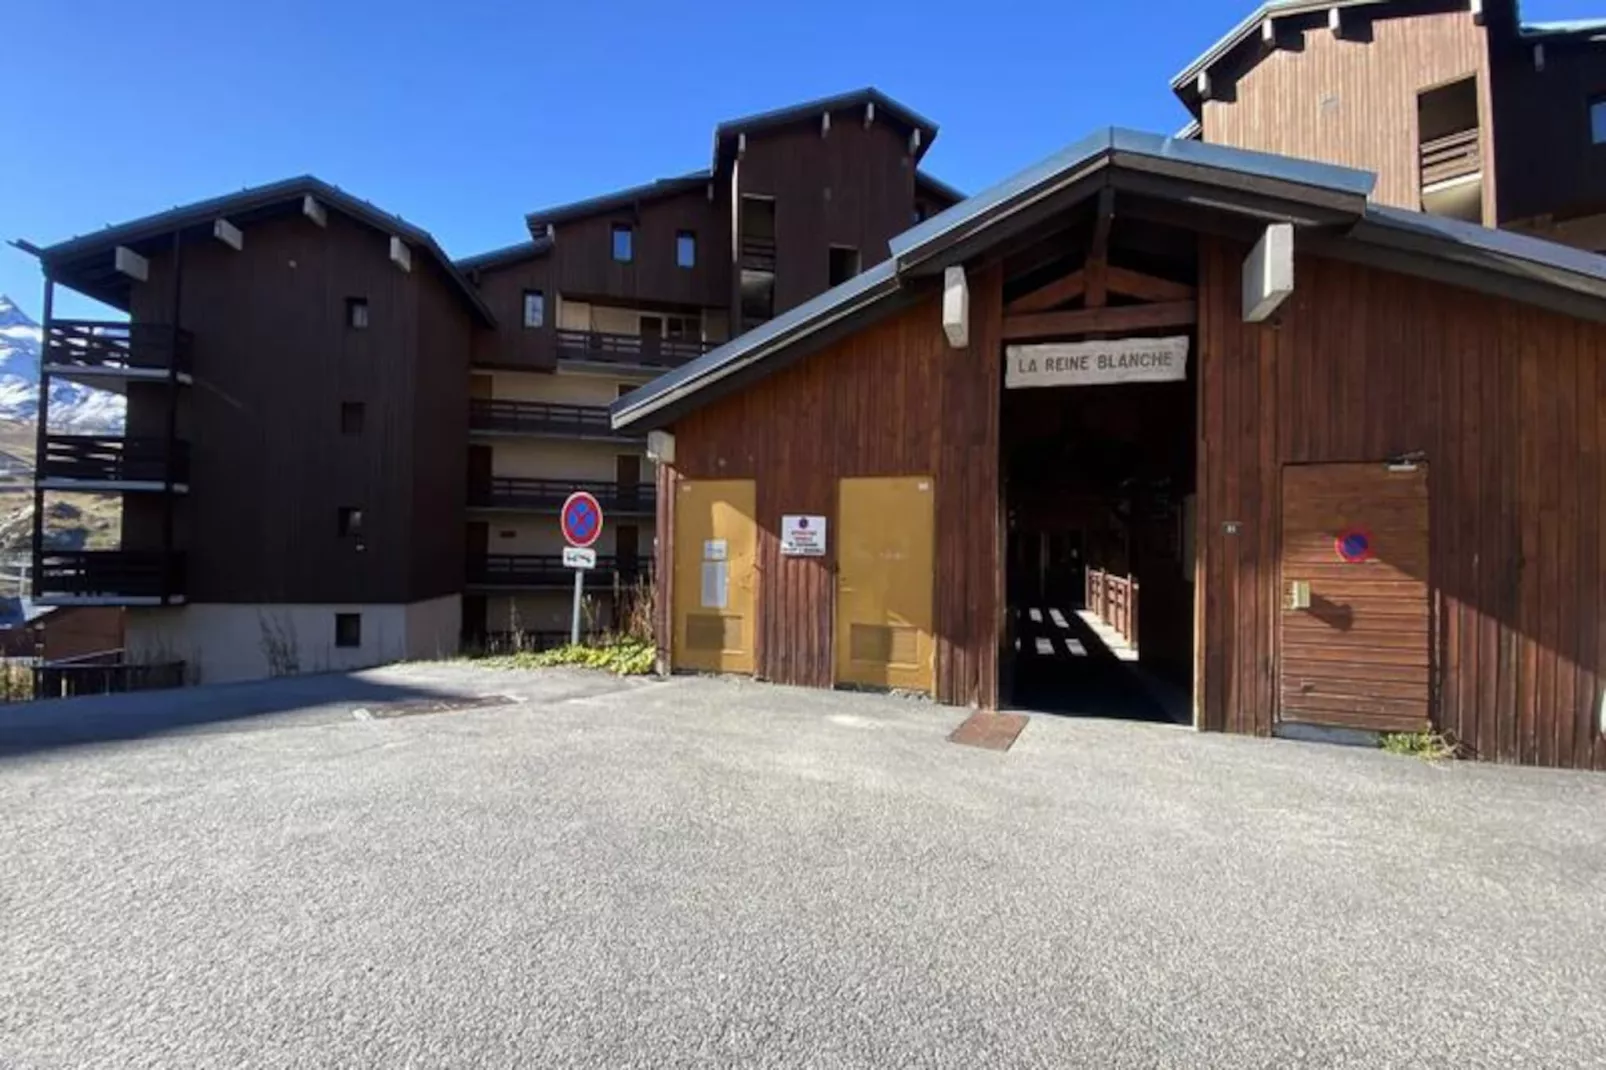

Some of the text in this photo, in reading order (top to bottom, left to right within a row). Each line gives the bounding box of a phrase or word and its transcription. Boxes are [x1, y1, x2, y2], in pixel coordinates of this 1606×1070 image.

[1018, 351, 1173, 374] LA REINE BLANCHE
